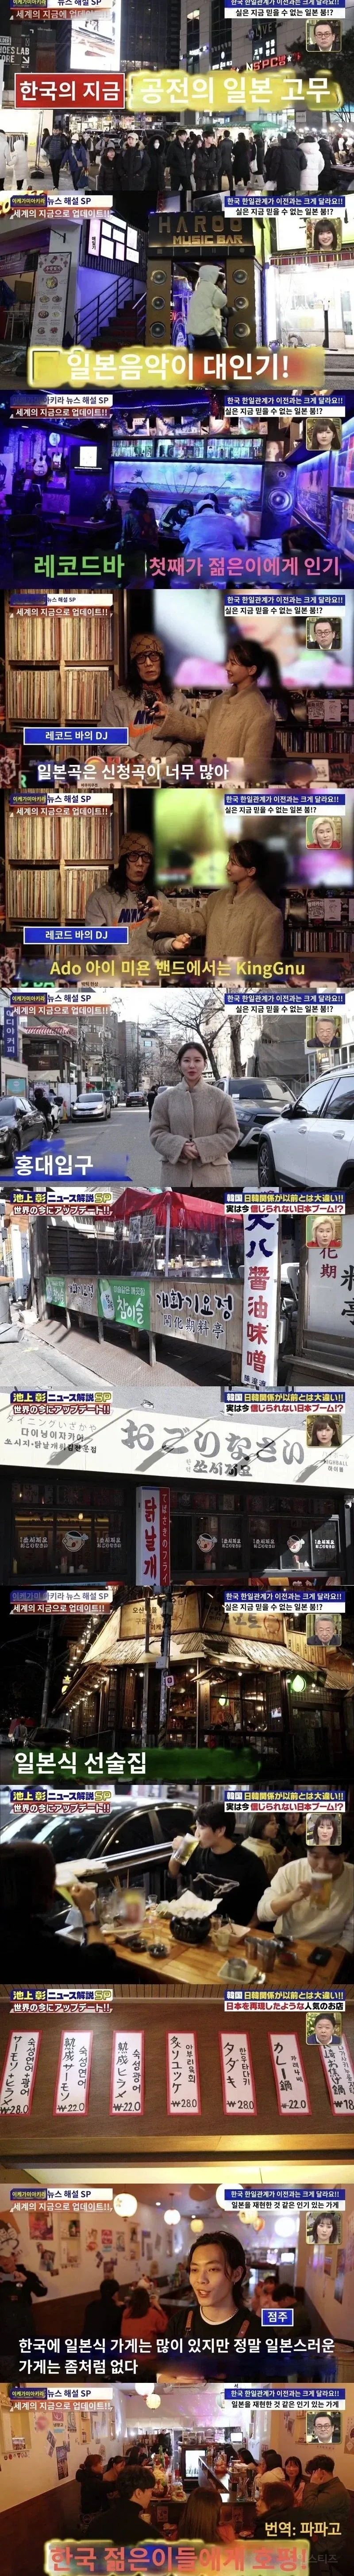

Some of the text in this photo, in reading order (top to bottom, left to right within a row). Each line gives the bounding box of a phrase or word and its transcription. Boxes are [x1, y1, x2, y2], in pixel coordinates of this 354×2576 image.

[173, 235, 243, 244] MUSIC BAR
[6, 1009, 15, 1054] 이디야커피
[69, 1282, 94, 1298] 개화기요정
[113, 1286, 145, 1296] 이슬같은 깨끗함
[156, 1290, 233, 1320] 개화기요정
[116, 1295, 144, 1325] 참이슬
[163, 1314, 224, 1339] 開化期料亭
[7, 1415, 97, 1432] ダイニングいざかや
[121, 1419, 305, 1465] おごりなさい
[143, 1497, 157, 1581] 닭날개
[20, 2037, 36, 2096] 숙성연어+광어
[77, 2046, 88, 2089] 숙성연어
[115, 2041, 129, 2099] 熟成ヒラメ
[132, 2049, 141, 2093] 숙성광어
[186, 2044, 196, 2083] 아부리육회
[223, 2042, 239, 2088] タダキ
[239, 2047, 250, 2086] 한우타다키
[273, 2042, 292, 2091] カレー鍋
[290, 2055, 304, 2083] 카레나베
